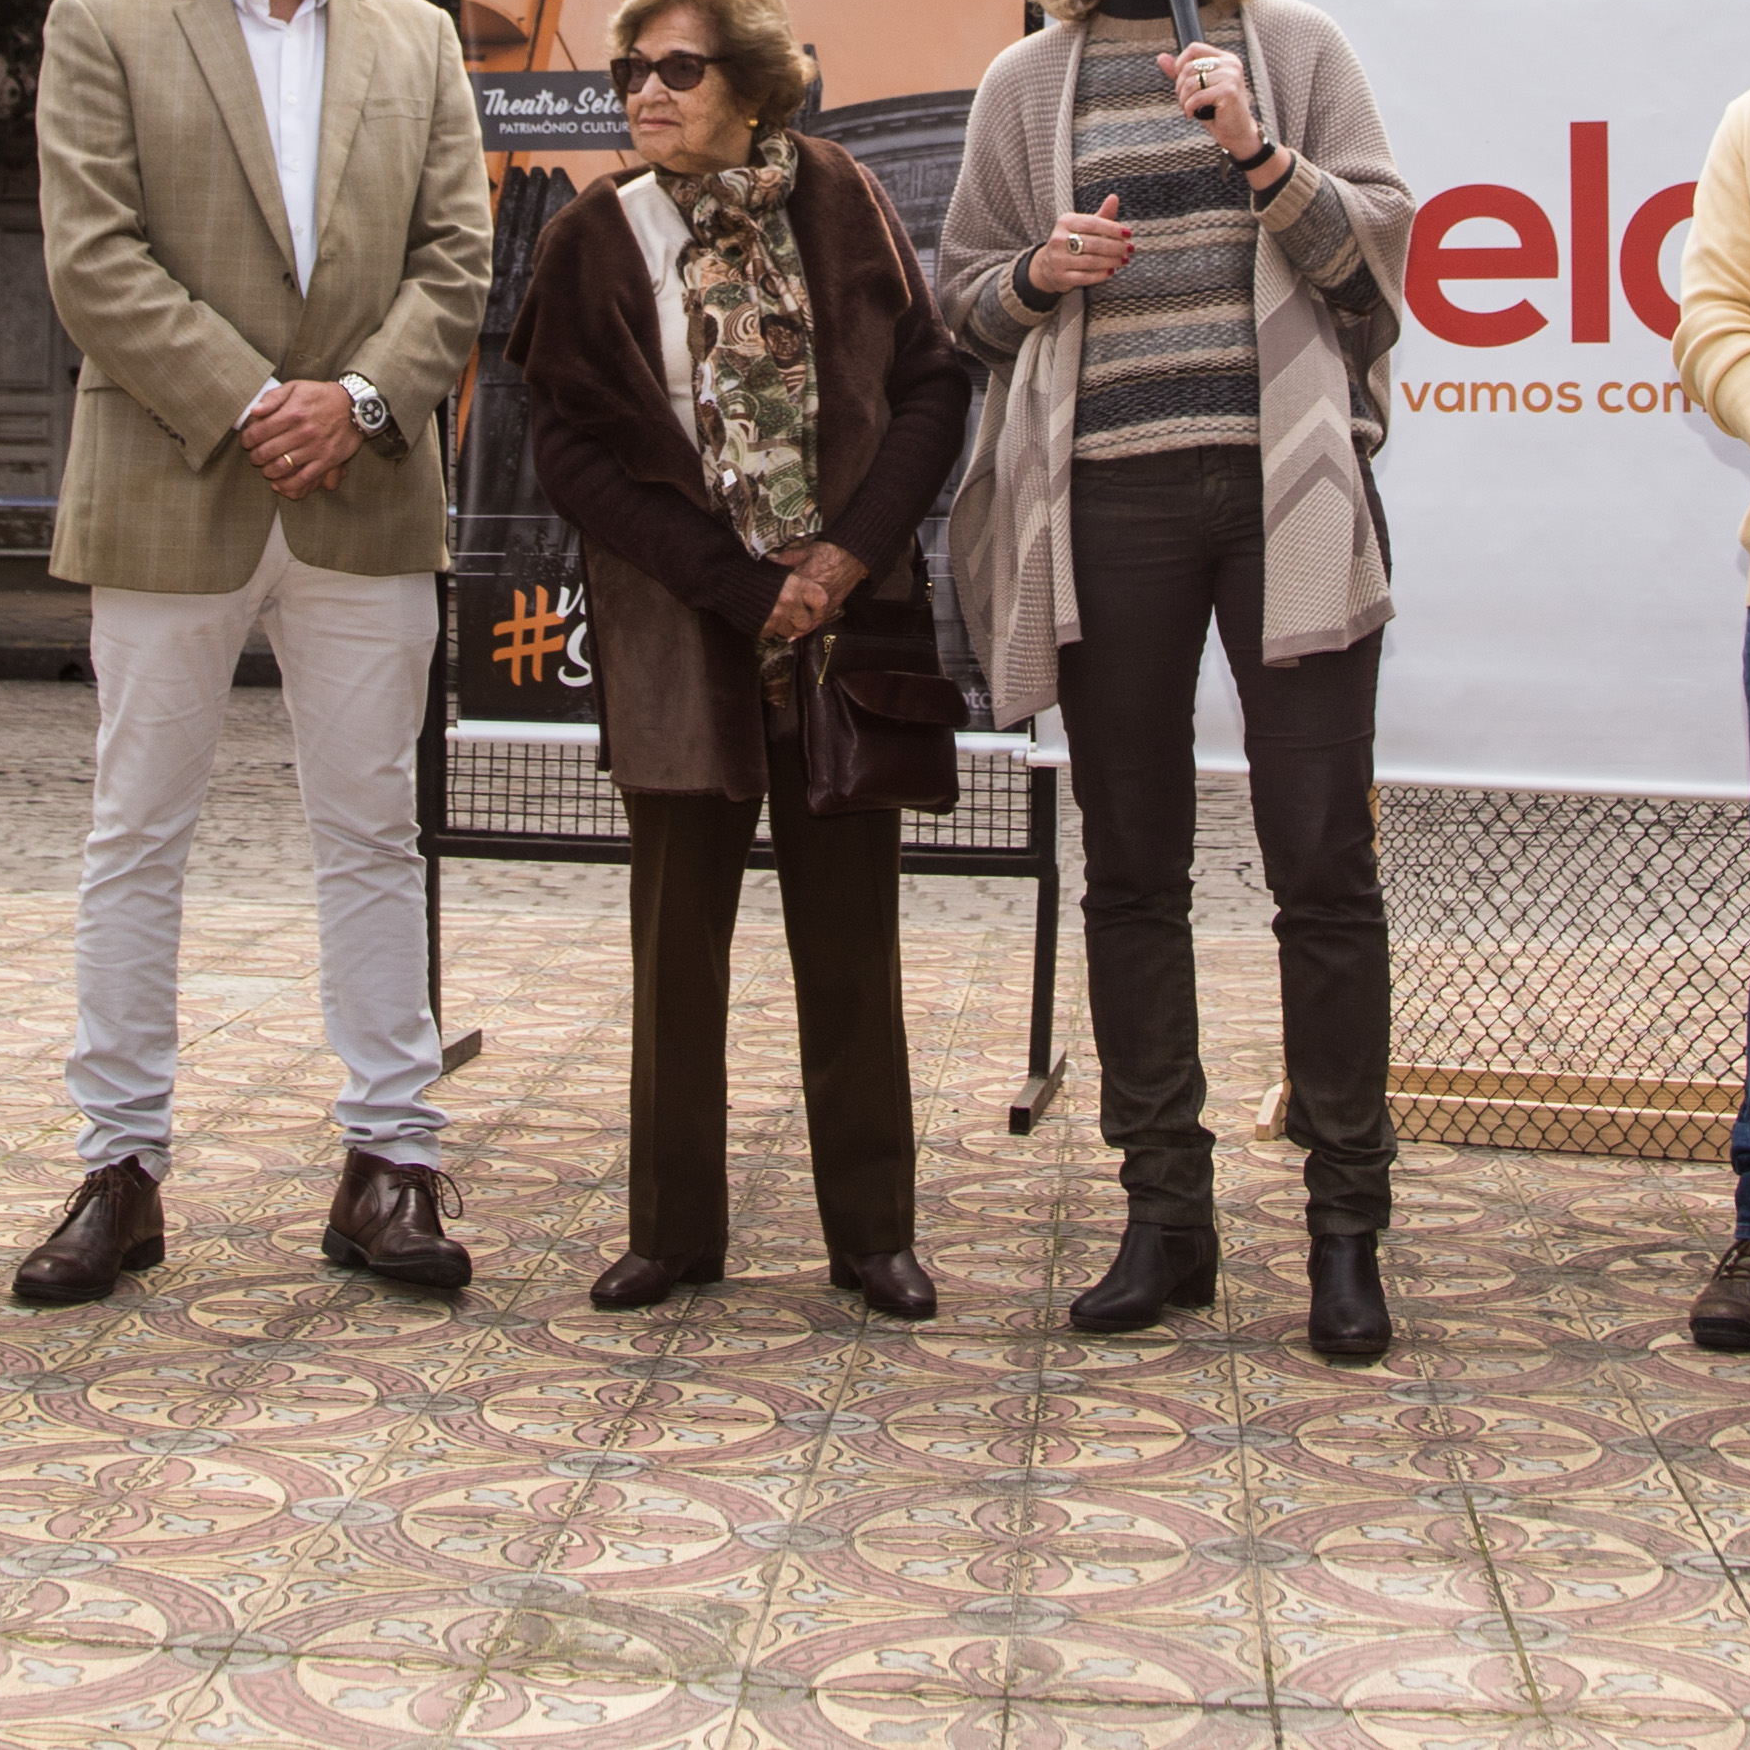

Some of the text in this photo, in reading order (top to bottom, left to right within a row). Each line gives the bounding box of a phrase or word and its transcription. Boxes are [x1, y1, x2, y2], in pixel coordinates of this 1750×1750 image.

[483, 87, 625, 116] Theatro Sete
[500, 120, 577, 135] PATRIMÔNIO
[1401, 381, 1583, 413] vamos
